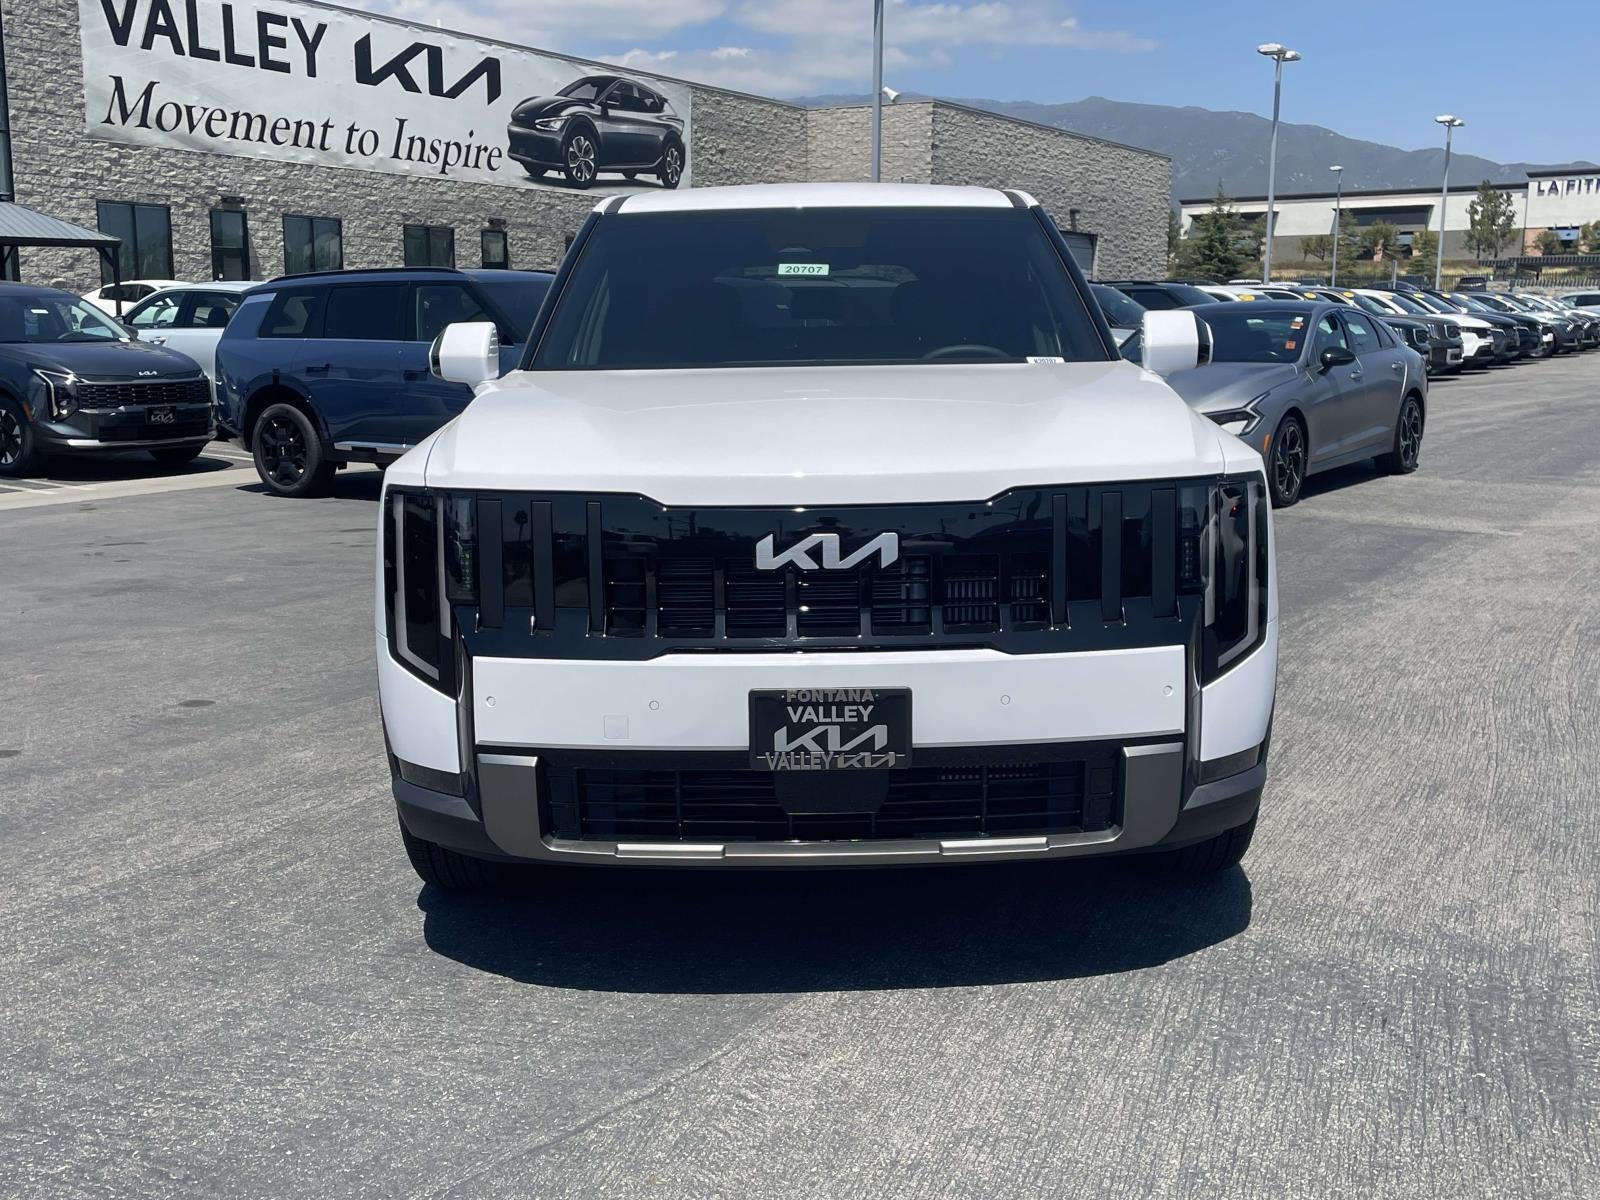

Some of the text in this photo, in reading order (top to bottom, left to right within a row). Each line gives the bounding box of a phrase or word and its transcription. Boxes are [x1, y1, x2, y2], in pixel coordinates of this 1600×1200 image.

[101, 0, 502, 106] VALLEY KIA
[101, 75, 503, 175] Movement to Inspire
[1536, 180, 1559, 196] LA
[785, 265, 823, 274] 20707
[755, 532, 899, 569] KIA
[786, 688, 875, 703] FONTANA
[787, 705, 874, 723] VALLEY
[774, 724, 888, 752] KIA
[766, 752, 896, 770] VALLEY KIA
